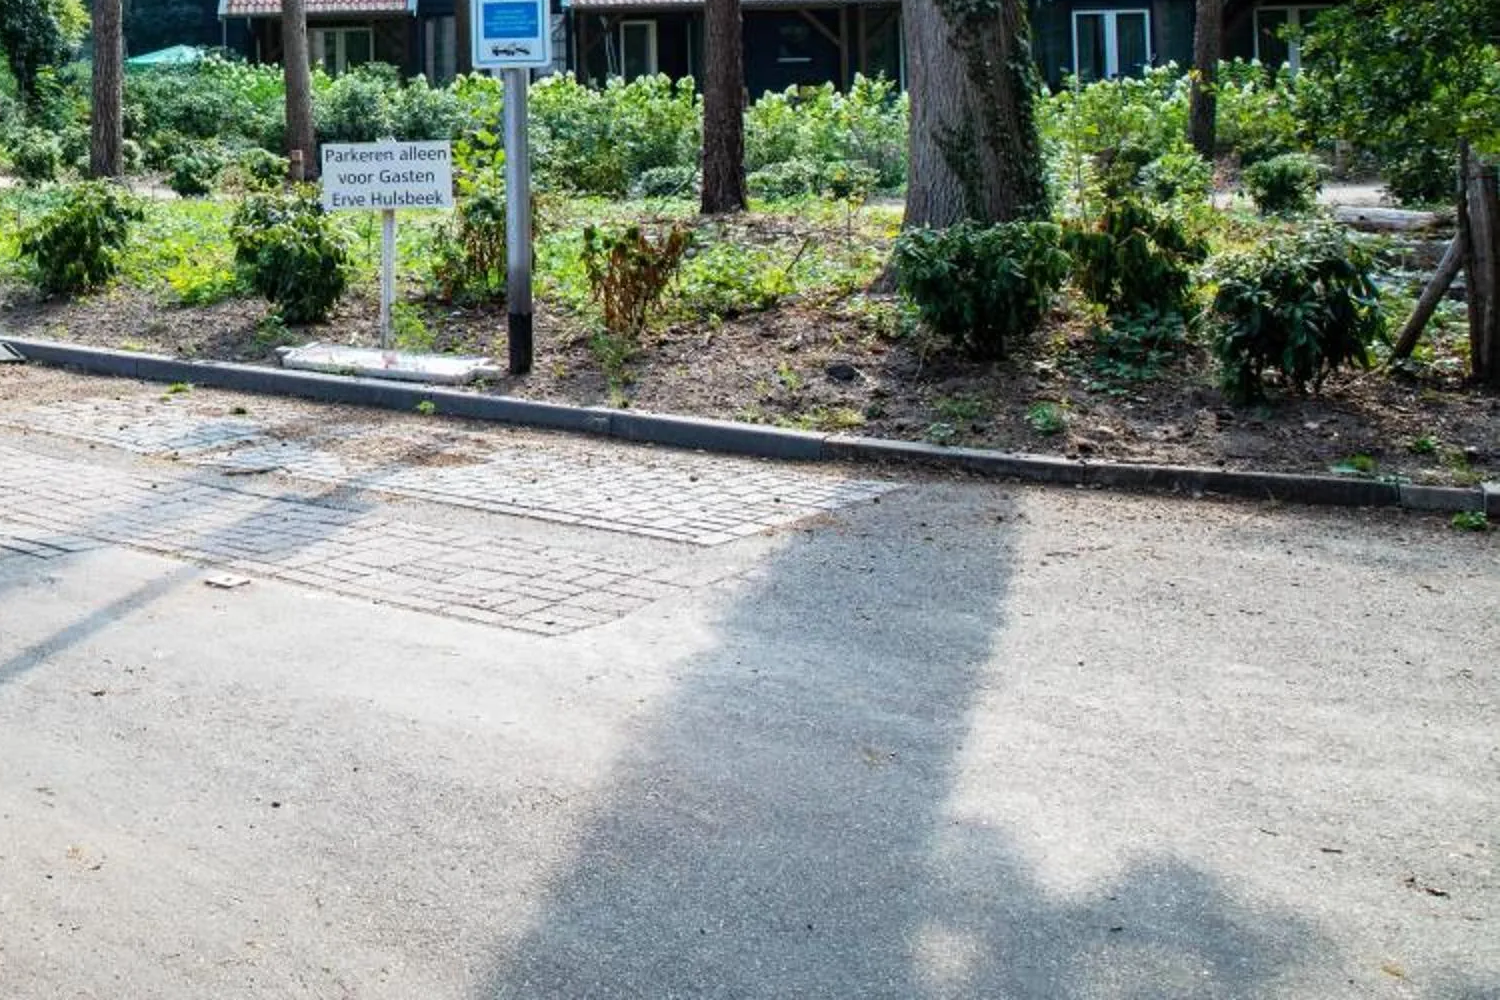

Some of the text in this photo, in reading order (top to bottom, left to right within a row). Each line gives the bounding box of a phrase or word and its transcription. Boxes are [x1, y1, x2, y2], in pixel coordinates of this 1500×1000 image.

[325, 146, 447, 163] Parkeren alleen
[338, 169, 435, 185] voor Gasten
[331, 190, 444, 207] Erve Hulsbeek
